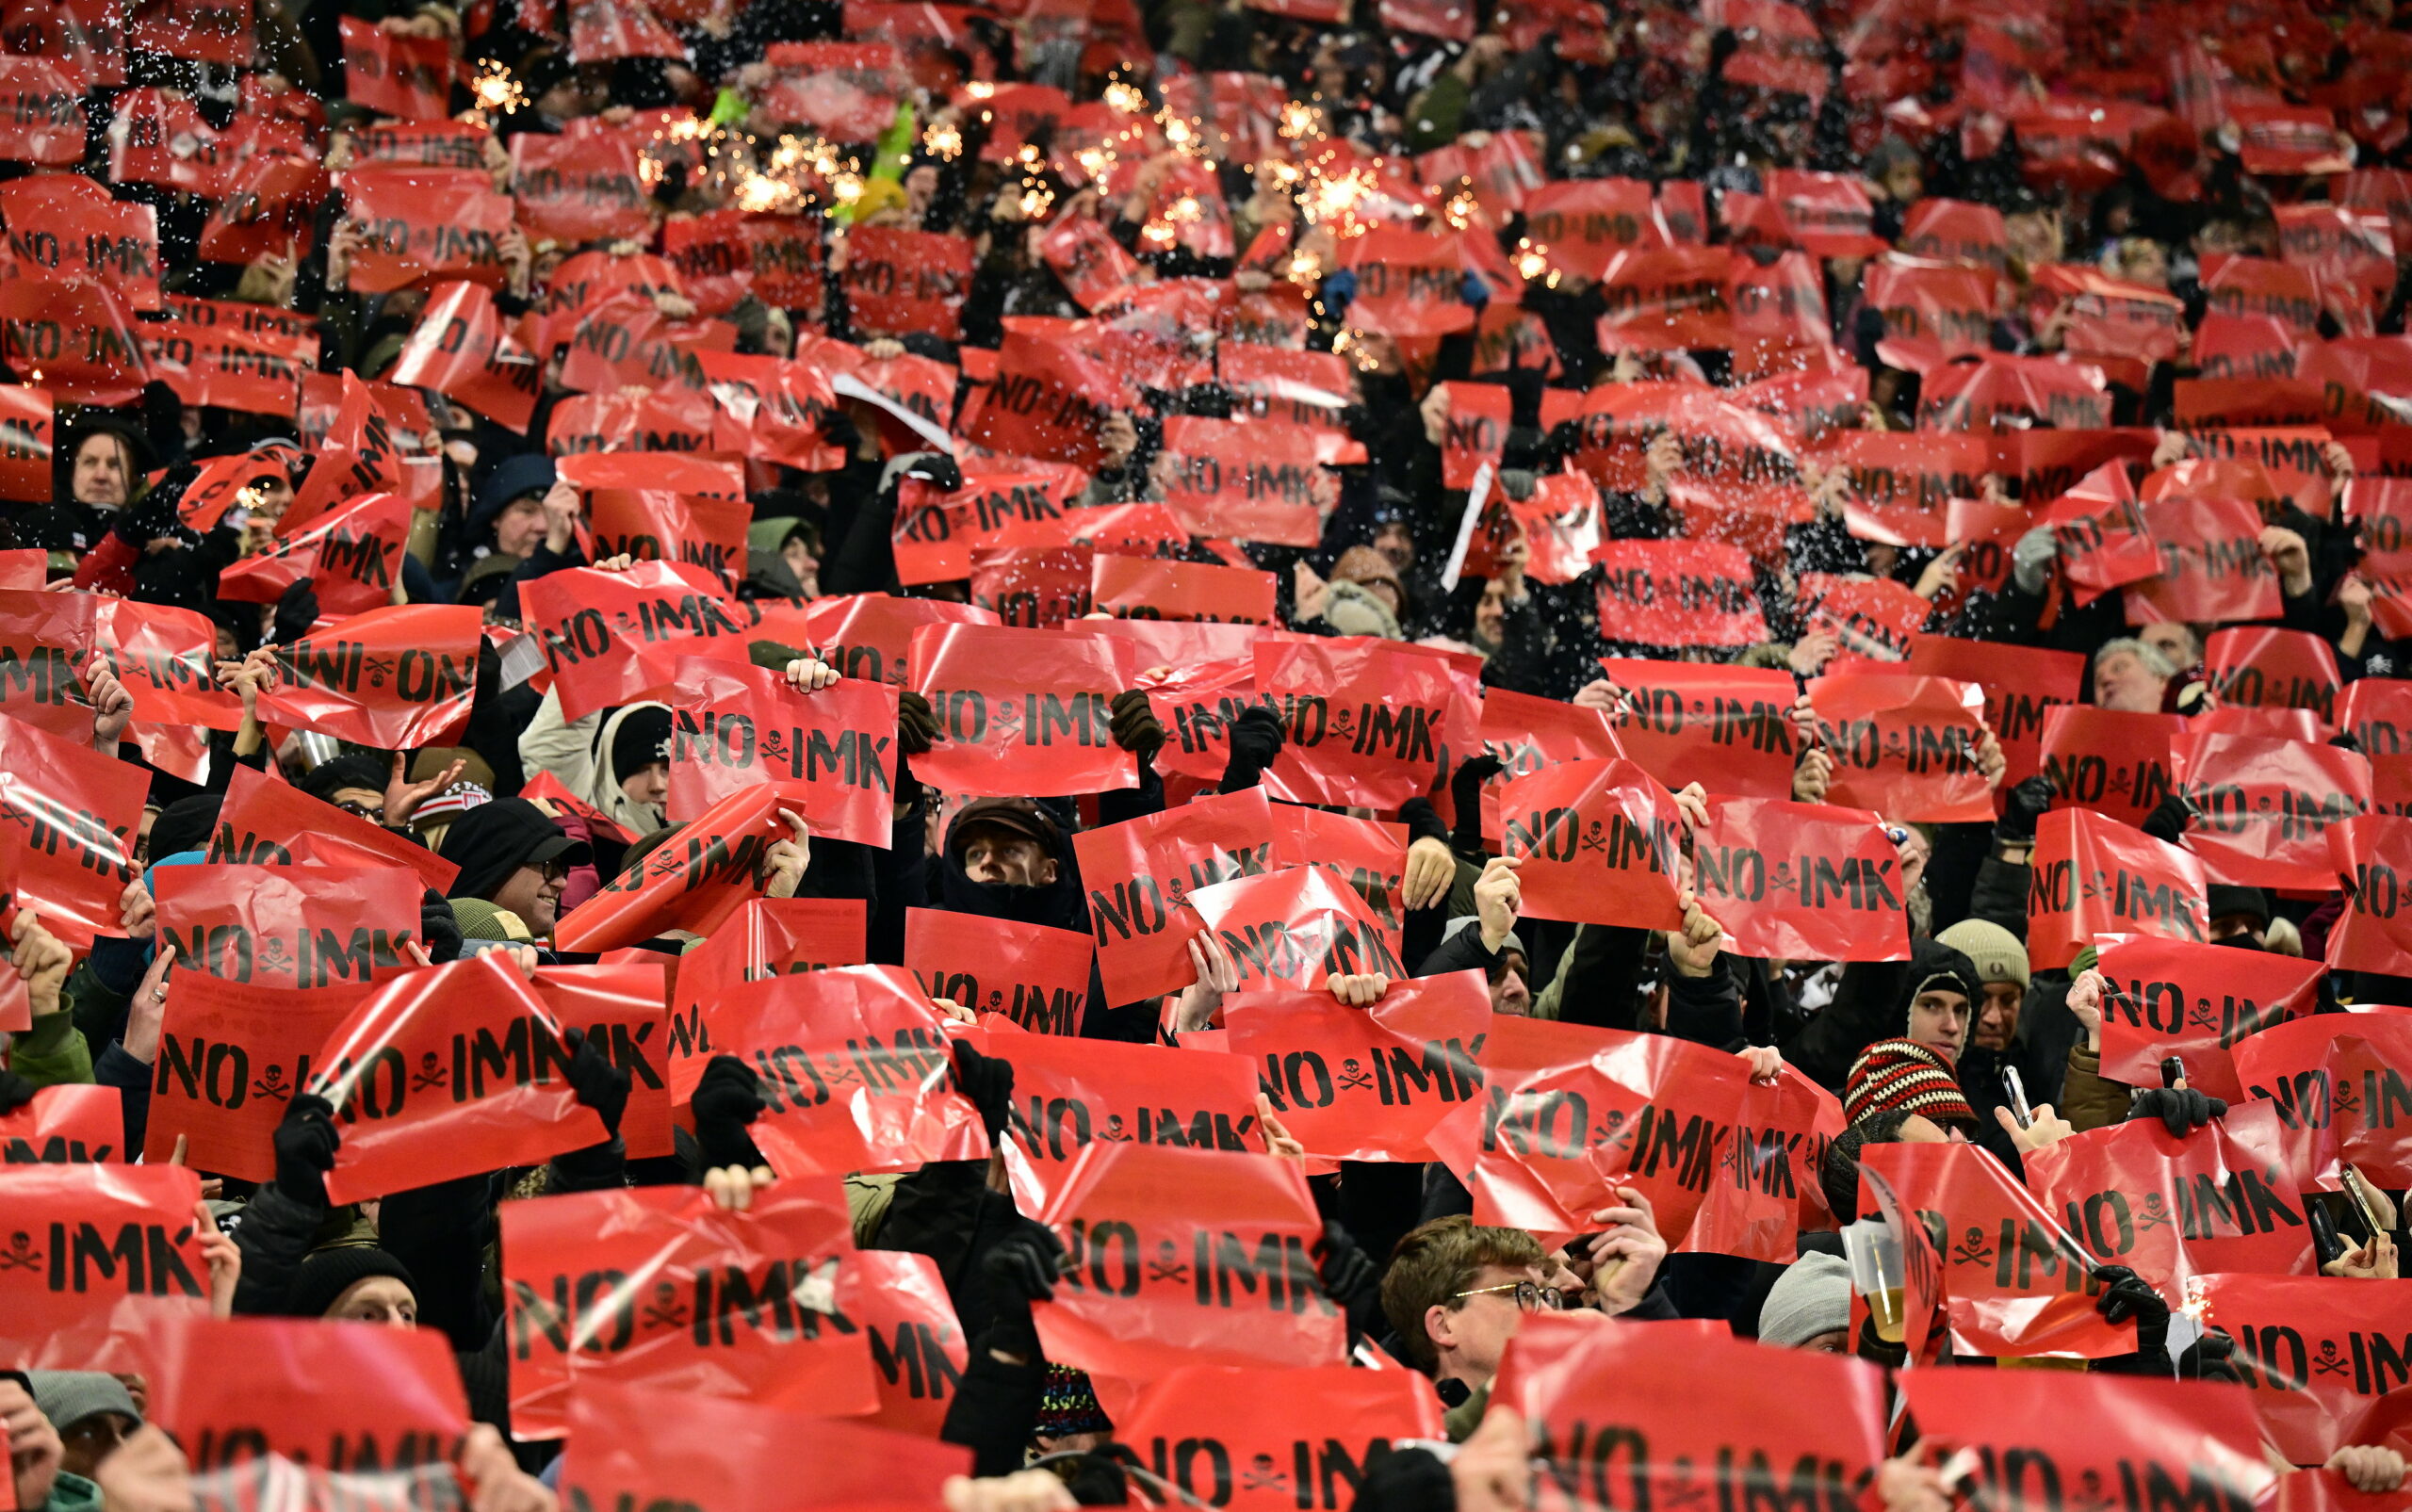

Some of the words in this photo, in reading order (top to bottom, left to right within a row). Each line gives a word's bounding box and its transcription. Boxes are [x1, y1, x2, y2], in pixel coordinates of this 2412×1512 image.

[9, 231, 59, 268] NO
[86, 234, 155, 278] IMK
[3, 317, 60, 360] NO
[86, 324, 138, 368] IM
[220, 345, 296, 382] IMK
[574, 317, 631, 360] NO
[986, 373, 1042, 415] NO
[1445, 414, 1497, 452] NO
[2260, 436, 2329, 479] IMK
[895, 503, 951, 545] NO
[973, 485, 1061, 532] IMK
[1244, 464, 1313, 506] IMK
[319, 526, 400, 591] IMK
[1602, 561, 1655, 606] NO
[1682, 569, 1752, 615] IMK
[542, 608, 611, 675] NO
[637, 594, 741, 642] IMK
[397, 647, 476, 704] NO
[677, 709, 755, 769] NO
[790, 725, 891, 794] IMK
[1264, 692, 1327, 748] NO
[1351, 702, 1442, 763] IMK
[1619, 686, 1683, 736] NO
[1711, 695, 1794, 755] IMK
[1815, 718, 1881, 771] NO
[1906, 723, 1984, 775] IMK
[2043, 754, 2107, 803] NO
[2184, 782, 2245, 835] NO
[30, 797, 132, 884] IMK
[1506, 806, 1580, 863] NO
[1696, 843, 1766, 902] NO
[1801, 854, 1902, 912] IMK
[2029, 858, 2079, 917] NO
[2113, 868, 2205, 944] IMK
[2342, 863, 2399, 919] NO
[1091, 873, 1168, 949] NO
[162, 924, 252, 984] NO
[297, 928, 412, 990] IMK
[1004, 983, 1084, 1037] IMK
[2104, 976, 2185, 1035] NO
[155, 1032, 249, 1110] NO
[451, 1014, 577, 1103] IMK
[753, 1043, 830, 1114] NO
[1258, 1049, 1335, 1111] NO
[1370, 1032, 1488, 1106] IMK
[1008, 1095, 1094, 1162] NO
[1137, 1106, 1256, 1152] IMK
[2248, 1068, 2331, 1131] NO
[1481, 1084, 1590, 1160] NO
[1626, 1103, 1730, 1195] IMK
[1736, 1125, 1803, 1199] IMK
[2065, 1190, 2136, 1259] NO
[2174, 1164, 2305, 1241] IMK
[48, 1221, 204, 1298] IMK
[511, 1268, 635, 1360] NO
[692, 1258, 859, 1349] IMK
[2212, 1324, 2309, 1392] NO
